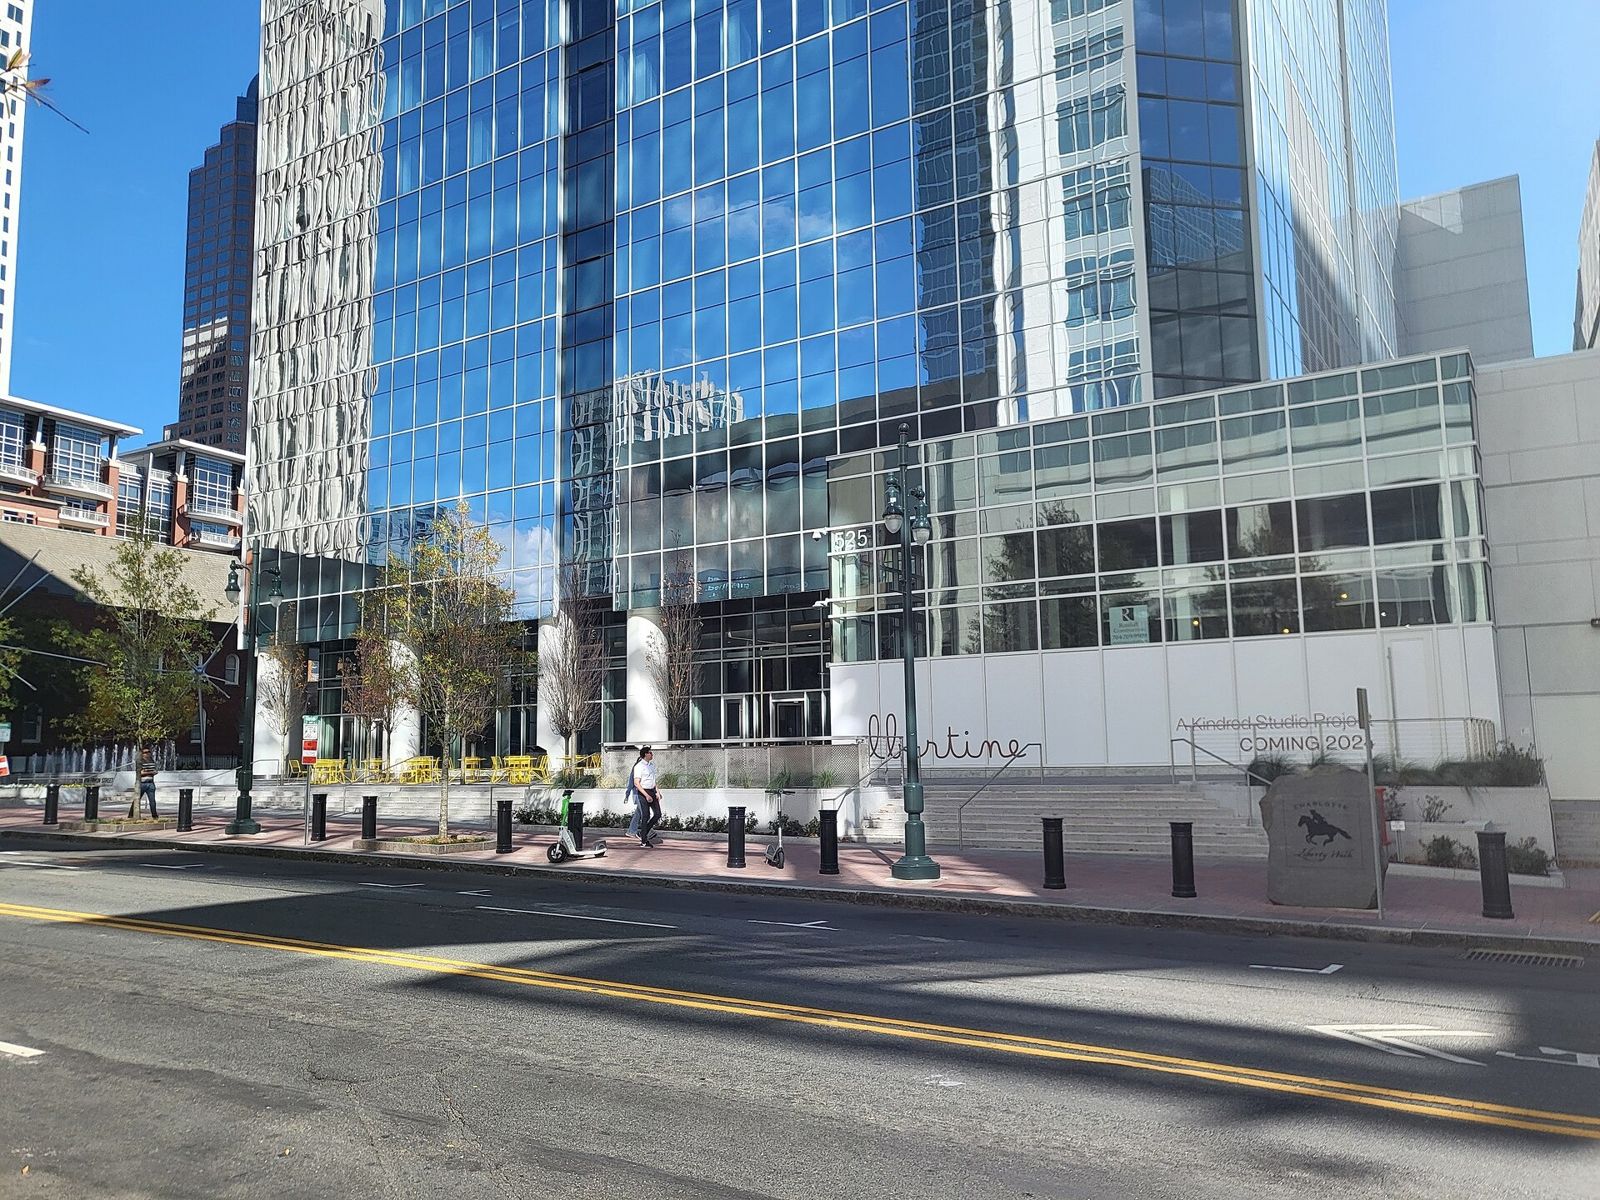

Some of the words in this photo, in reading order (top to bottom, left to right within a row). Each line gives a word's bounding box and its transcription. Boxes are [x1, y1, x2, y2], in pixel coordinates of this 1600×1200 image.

[834, 529, 868, 550] 525
[1176, 717, 1188, 731] A
[1192, 716, 1251, 731] Kindred
[1255, 713, 1309, 729] Studio
[1314, 712, 1373, 731] Proje
[1239, 736, 1320, 752] COMING
[1294, 848, 1328, 862] Liberty
[1330, 847, 1354, 859] Walk
